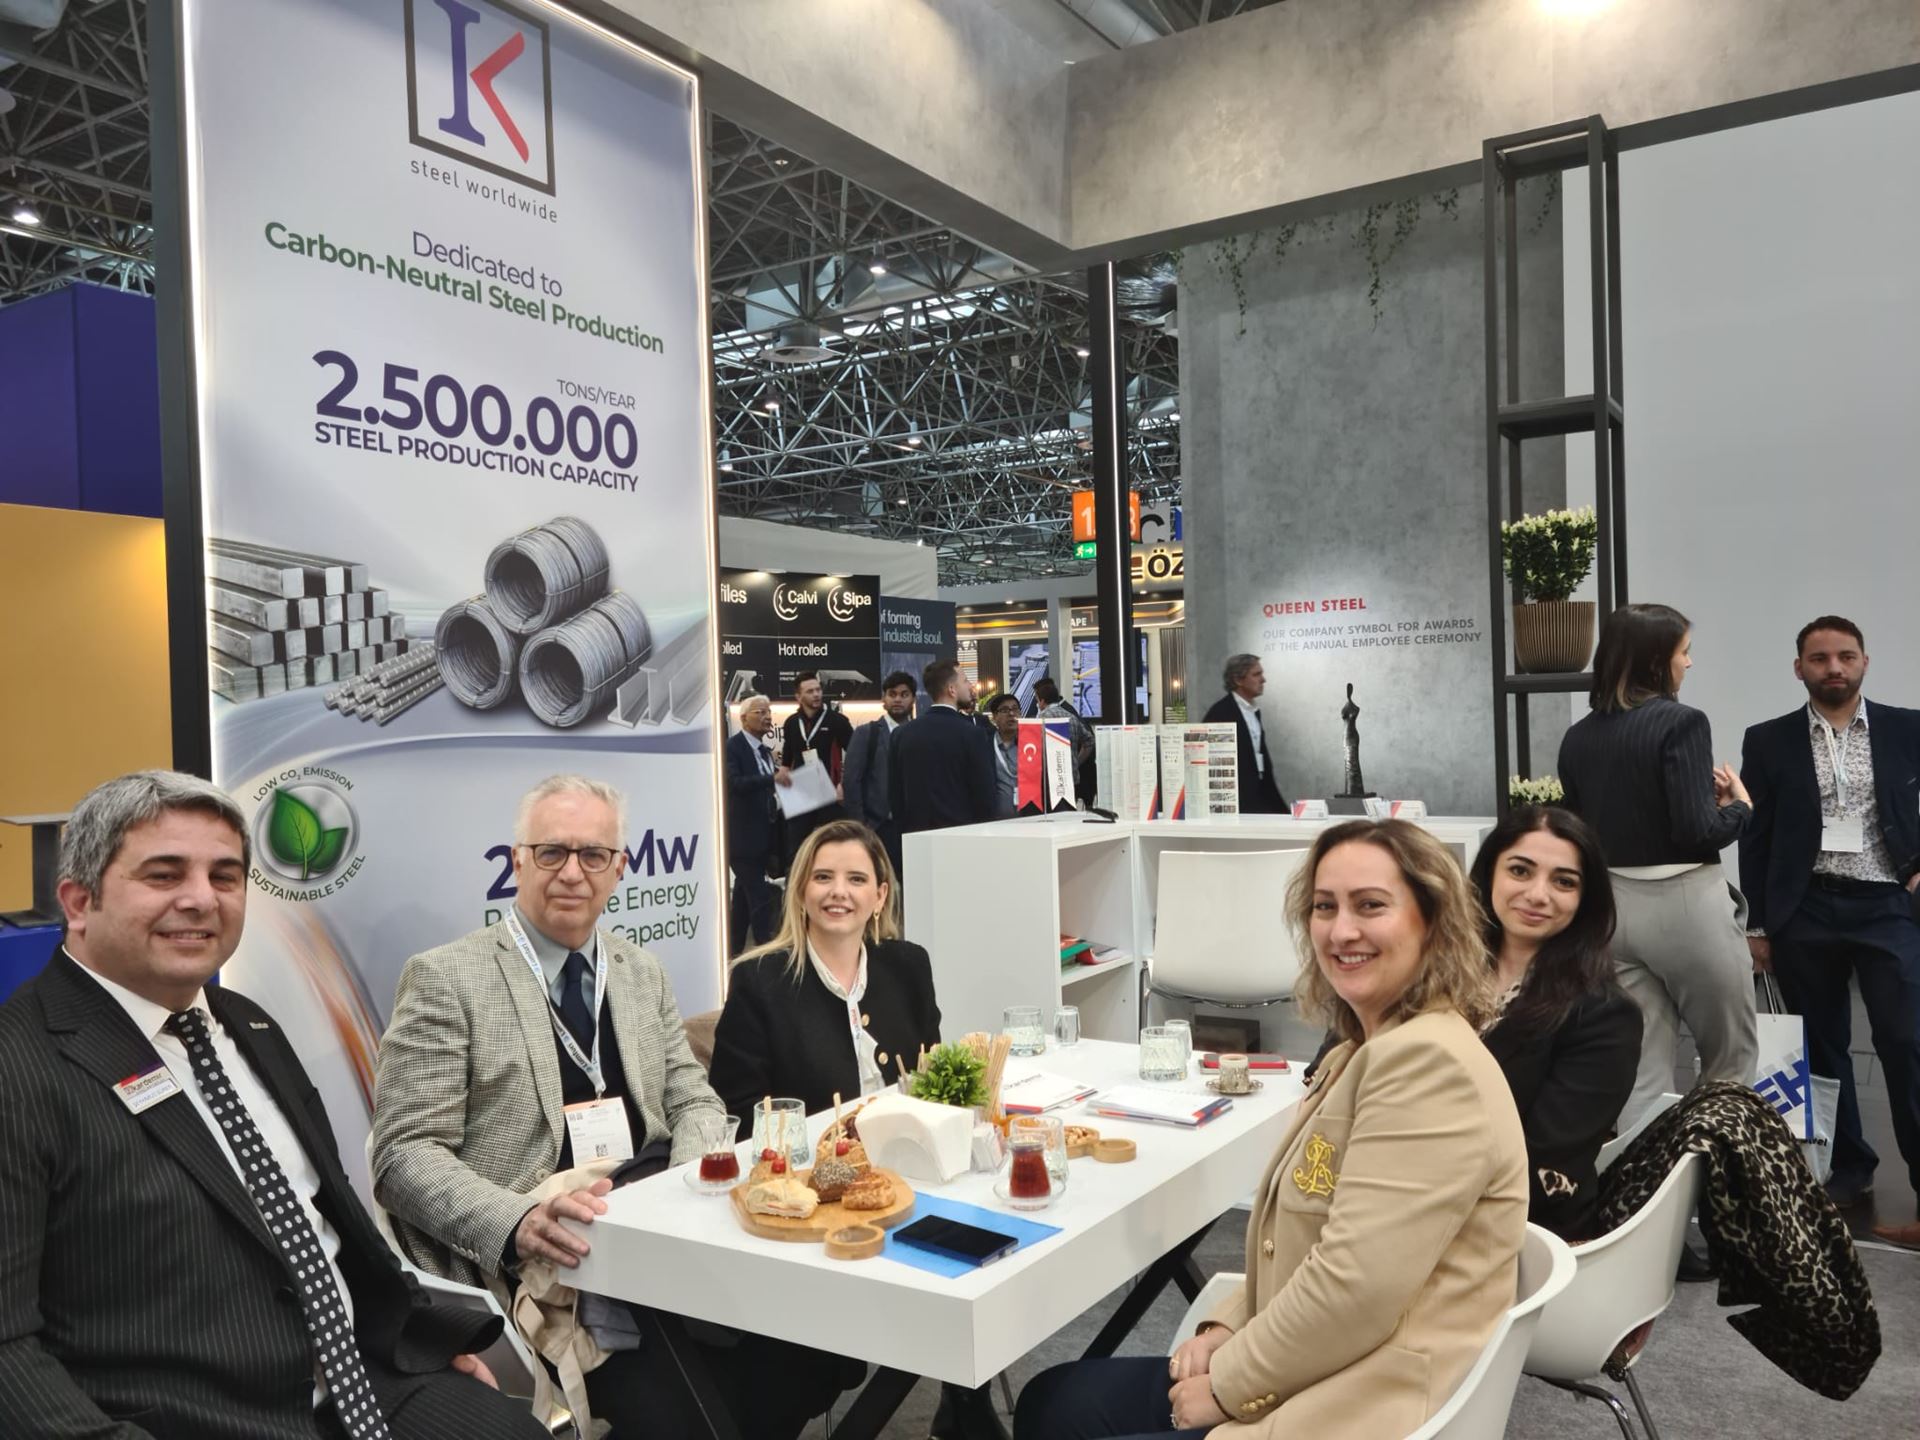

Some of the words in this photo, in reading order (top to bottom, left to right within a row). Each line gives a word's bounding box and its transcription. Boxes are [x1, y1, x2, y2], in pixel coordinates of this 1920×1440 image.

[411, 160, 459, 188] steel
[466, 179, 558, 224] worldwide
[413, 231, 535, 290] Dedicated
[540, 271, 562, 297] to
[265, 222, 482, 303] Carbon-Neutral
[489, 285, 545, 322] Steel
[552, 303, 663, 354] Production
[557, 379, 636, 410] TONS/YEAR
[312, 350, 638, 469] 2.500.000
[315, 421, 392, 454] STEEL
[398, 435, 544, 478] PRODUCTION
[550, 462, 638, 492] CAPACITY
[787, 590, 818, 605] Calvi
[843, 592, 872, 608] Sipa
[1263, 601, 1315, 618] QUEEN
[1321, 598, 1367, 612] STEEL
[888, 610, 921, 629] forming
[1263, 629, 1286, 640] OUR
[1289, 625, 1344, 638] COMPANY
[1348, 623, 1393, 635] SYMBOL
[1397, 621, 1420, 632] FOR
[1424, 618, 1475, 630] AWARDS
[778, 643, 796, 656] Hot
[798, 643, 828, 656] rolled
[883, 628, 922, 644] industrial
[924, 630, 943, 645] soul.
[1280, 641, 1299, 652] THE
[1303, 639, 1349, 650] ANNUAL
[1352, 635, 1411, 648] EMPLOYEE
[1414, 632, 1482, 645] CEREMONY
[253, 778, 278, 801] LOW
[303, 767, 354, 791] EMISSION
[249, 868, 334, 902] SUSTAINABLE
[335, 856, 366, 889] STEEL
[626, 882, 699, 911] Energy
